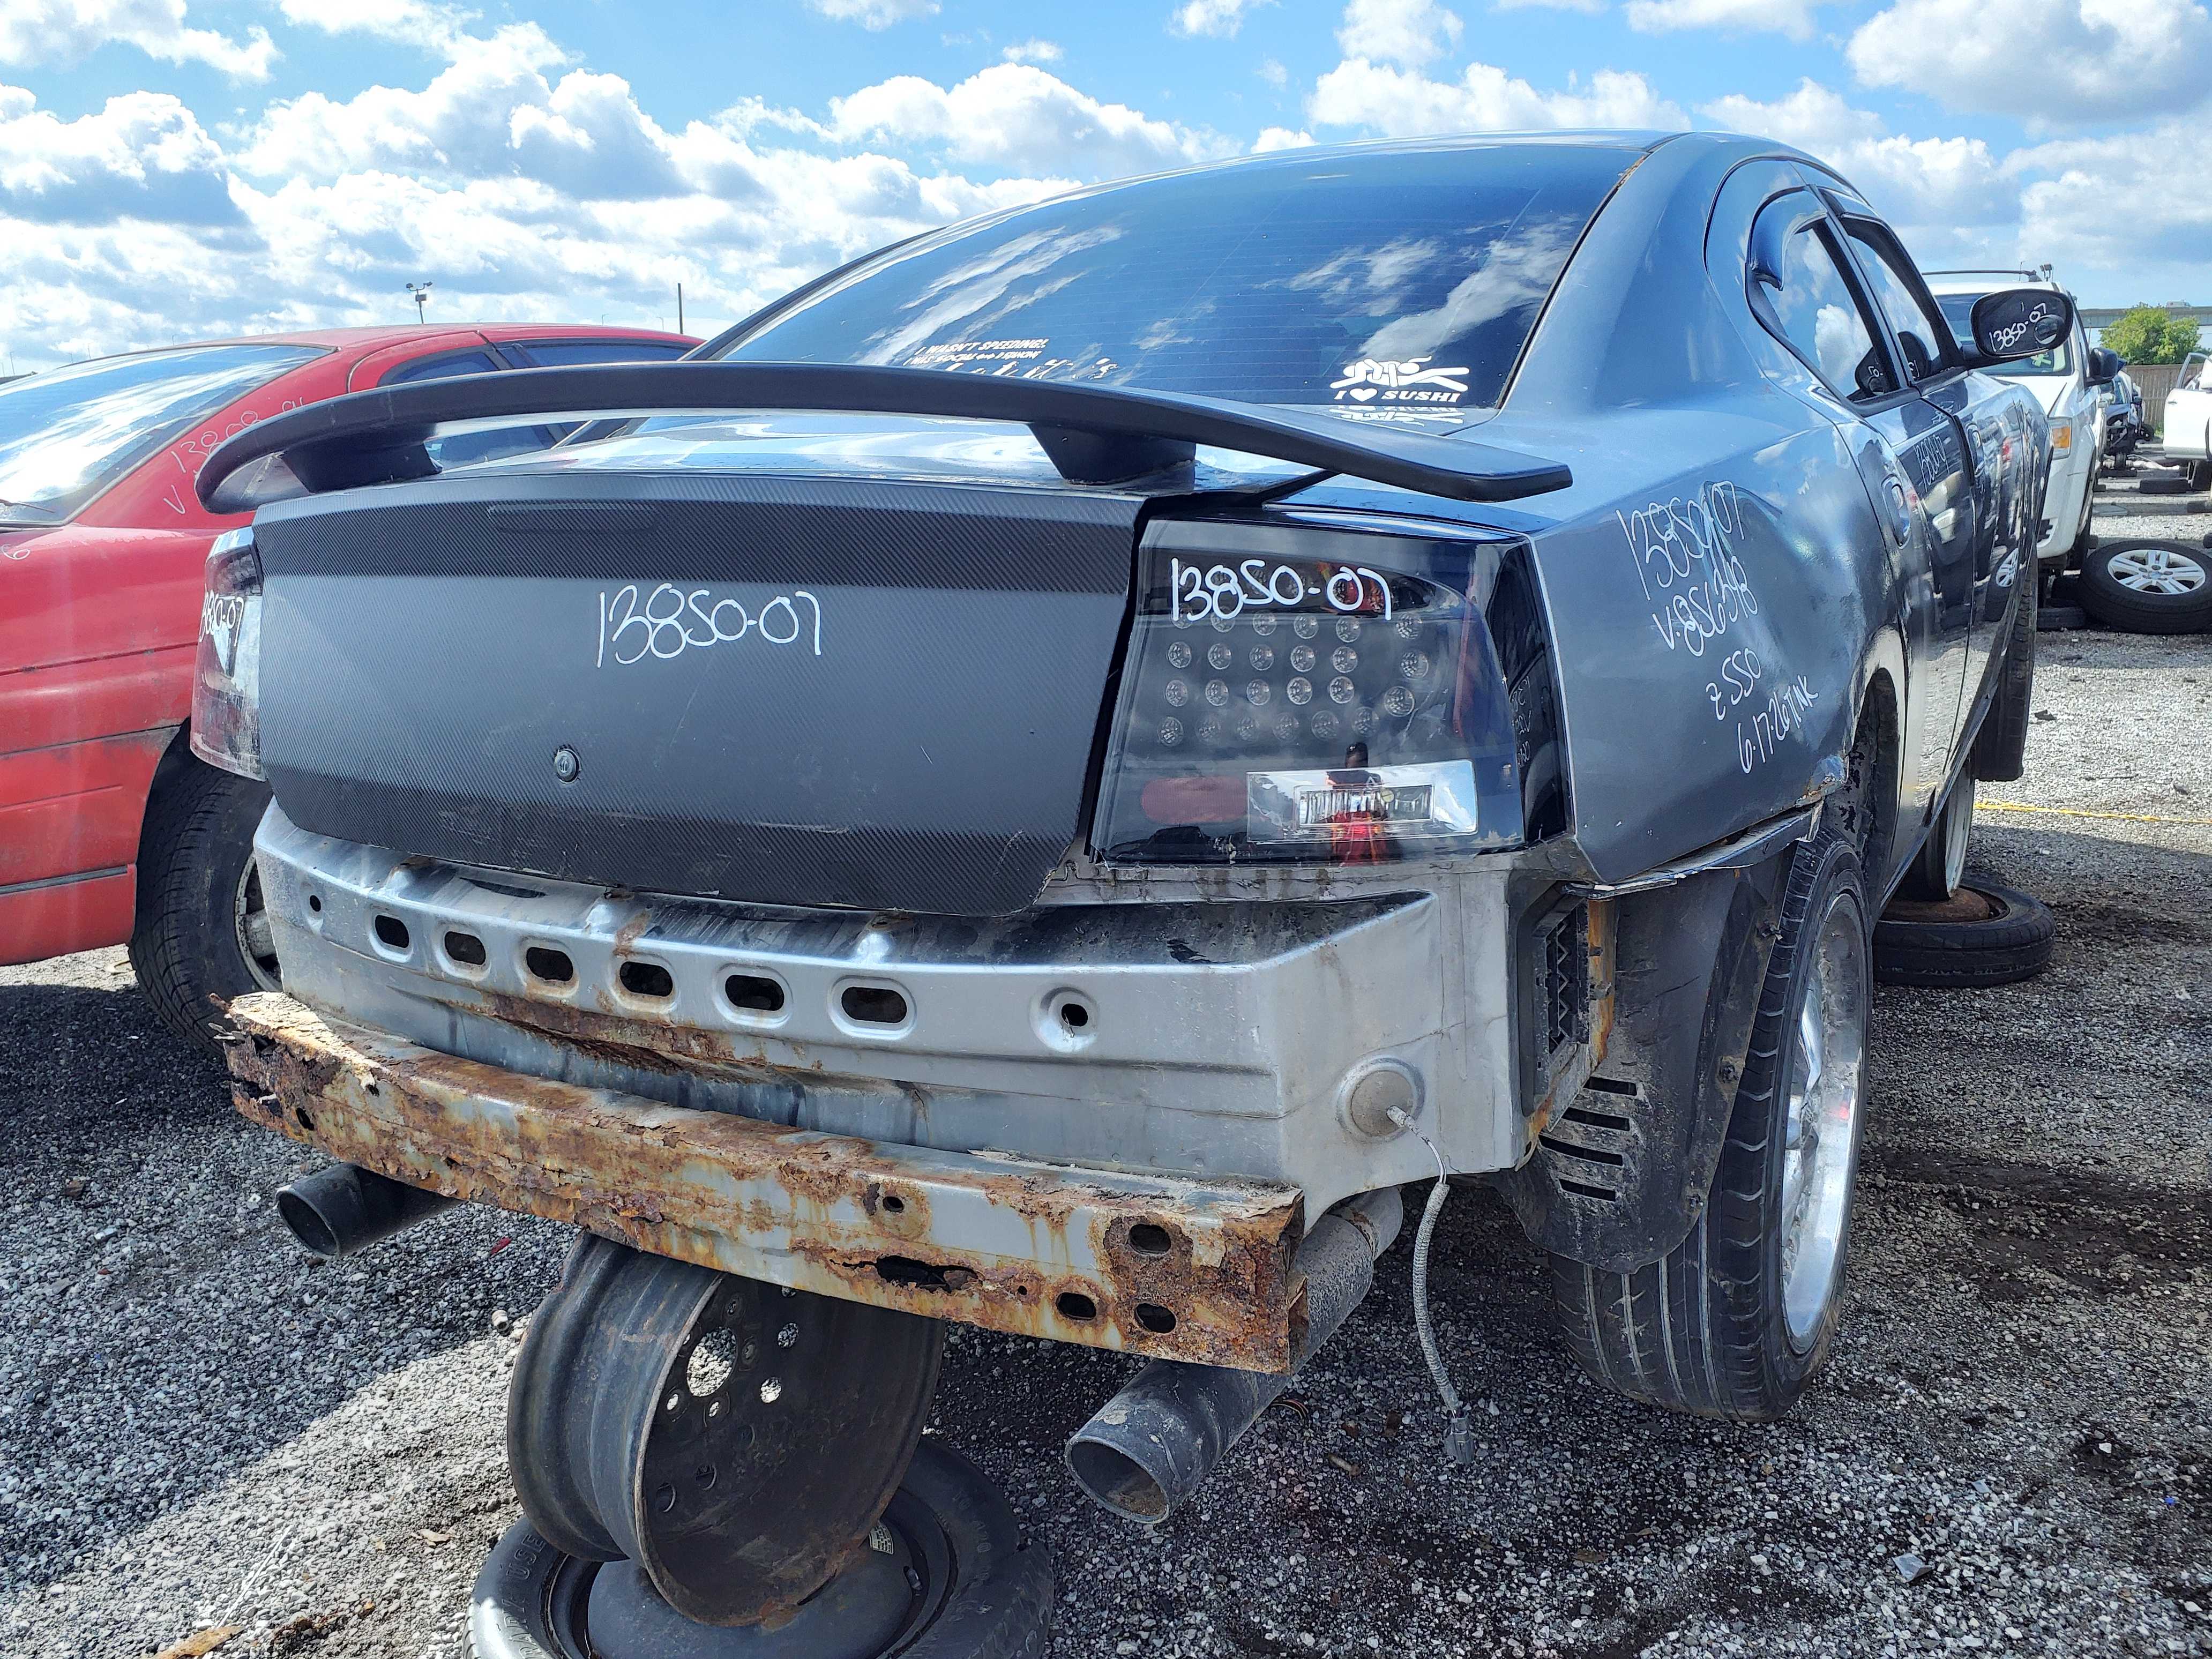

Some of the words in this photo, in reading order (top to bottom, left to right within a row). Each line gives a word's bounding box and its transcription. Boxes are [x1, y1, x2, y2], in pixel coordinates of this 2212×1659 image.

[915, 346, 926, 355] I
[925, 342, 981, 354] WASN'T
[977, 339, 1049, 350] SPEEDING!
[1334, 390, 1347, 400] I
[1381, 390, 1461, 403] SUSHI
[1171, 557, 1392, 621] 13850-07
[596, 582, 822, 668] 13850-07
